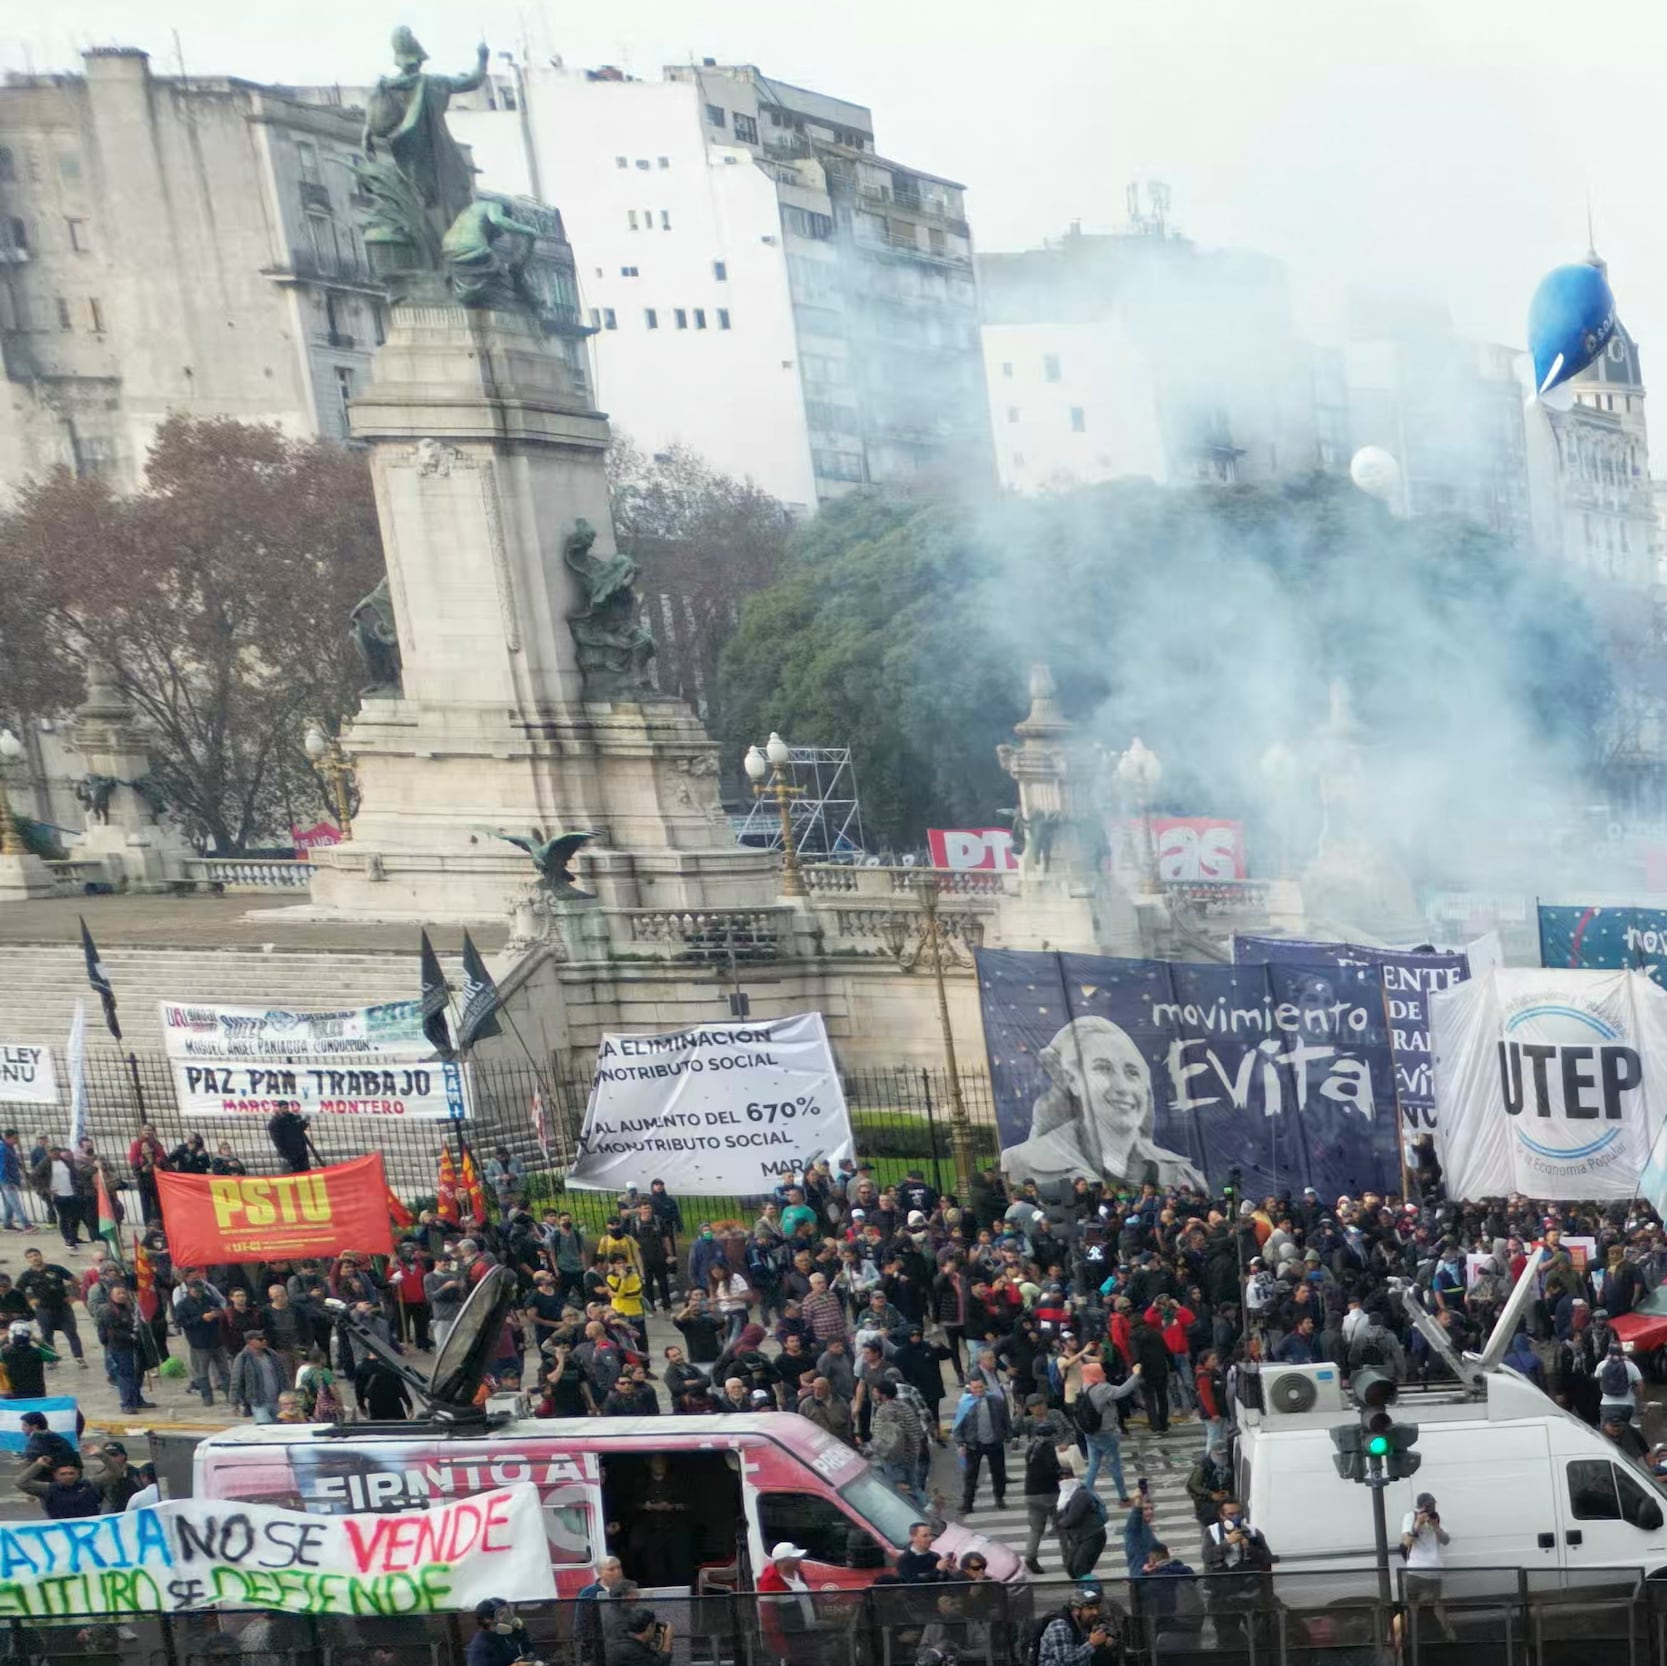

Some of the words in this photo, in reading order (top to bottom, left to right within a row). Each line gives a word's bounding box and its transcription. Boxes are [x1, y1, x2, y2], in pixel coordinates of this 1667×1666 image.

[1153, 995, 1368, 1033] movimiento
[1390, 1000, 1421, 1020] DE
[708, 1053, 779, 1071] SOCIAL
[1162, 1035, 1377, 1120] Evita
[247, 1069, 297, 1095] PAN
[308, 1069, 431, 1097] TRABAJO
[1498, 1041, 1643, 1120] UTEP
[319, 1100, 405, 1114] MONTERO
[706, 1111, 741, 1125] DEL
[746, 1096, 821, 1124] 670%
[725, 1131, 794, 1149] SOCIAL
[209, 1174, 332, 1228] PSTU
[174, 1512, 255, 1563] NO
[259, 1520, 328, 1568] SE
[344, 1494, 513, 1574] VENDE
[208, 1564, 456, 1617] DEFIENDE
